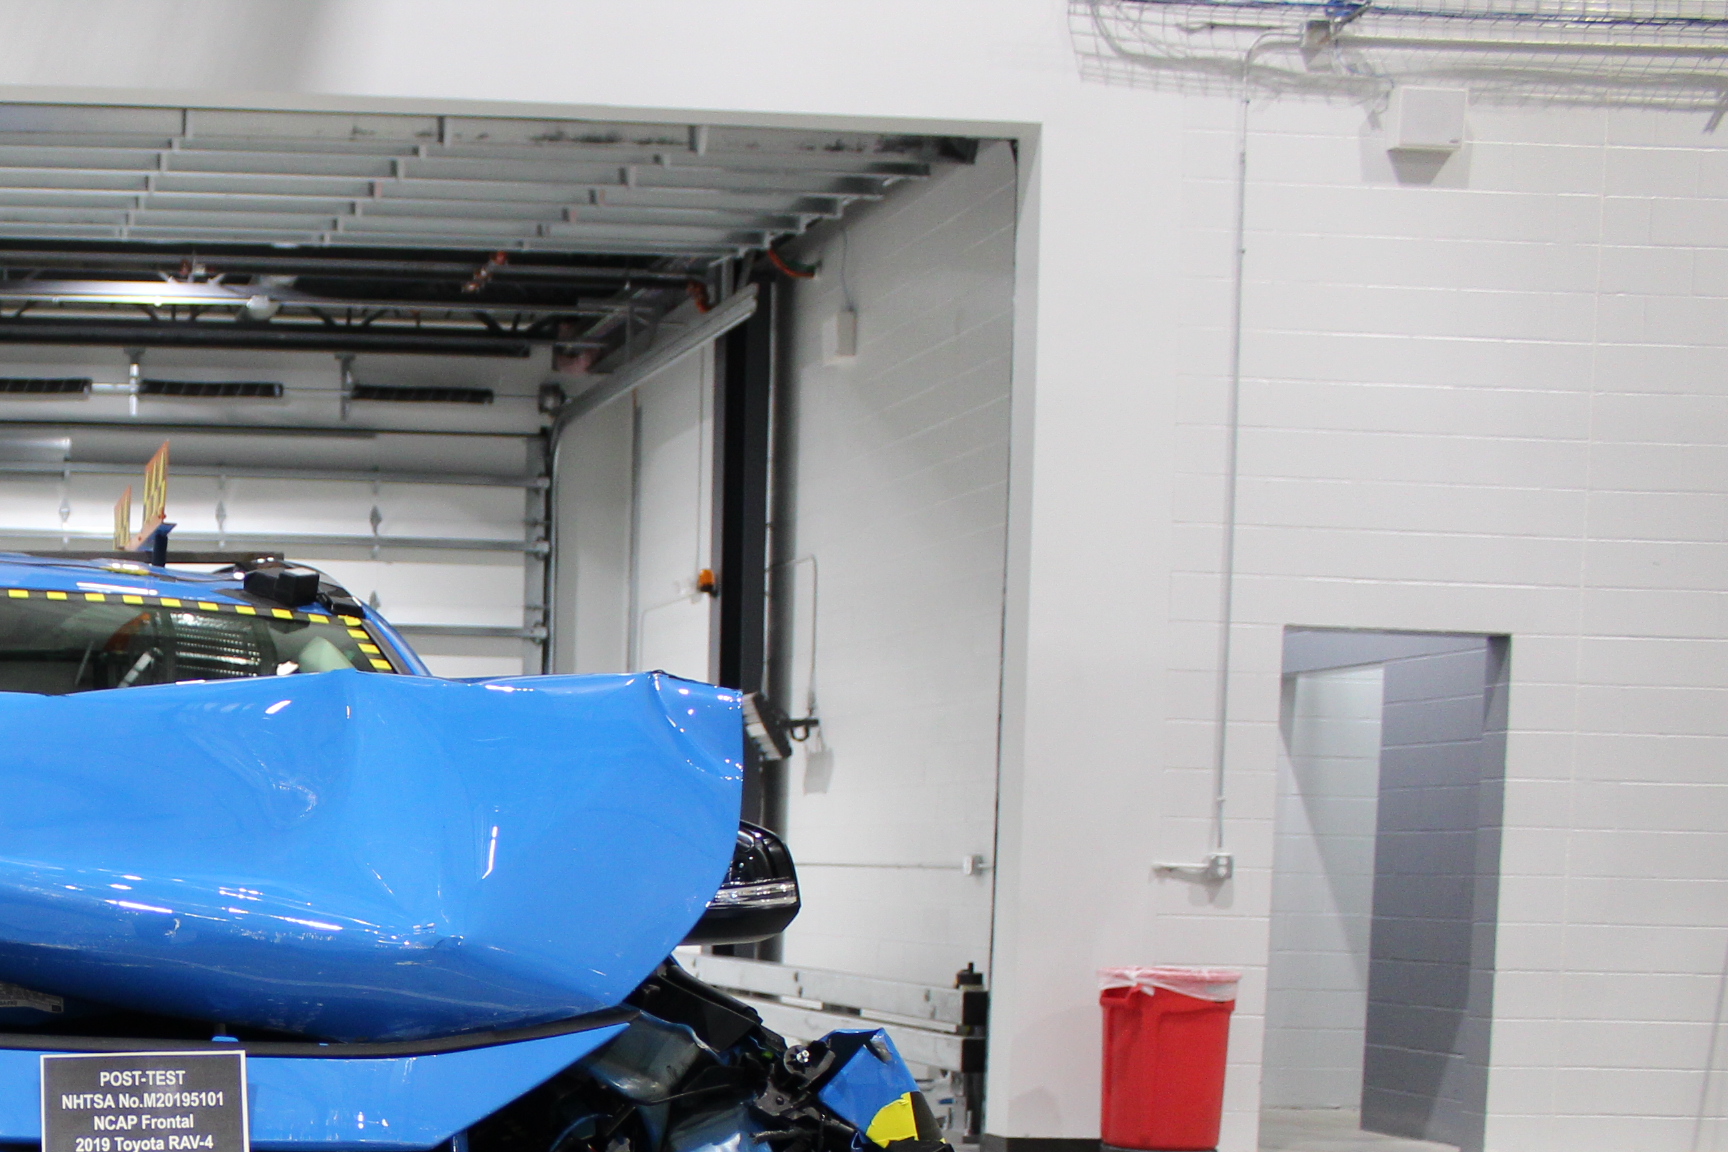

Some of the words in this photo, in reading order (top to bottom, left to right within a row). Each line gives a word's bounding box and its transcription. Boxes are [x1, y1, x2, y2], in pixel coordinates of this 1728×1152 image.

[101, 1071, 185, 1087] POST-TEST
[62, 1094, 115, 1109] NHTSA
[94, 1116, 137, 1130] NCAP
[142, 1114, 193, 1129] Frontal
[76, 1138, 110, 1152] 2019
[169, 1135, 213, 1149] RAV-4
